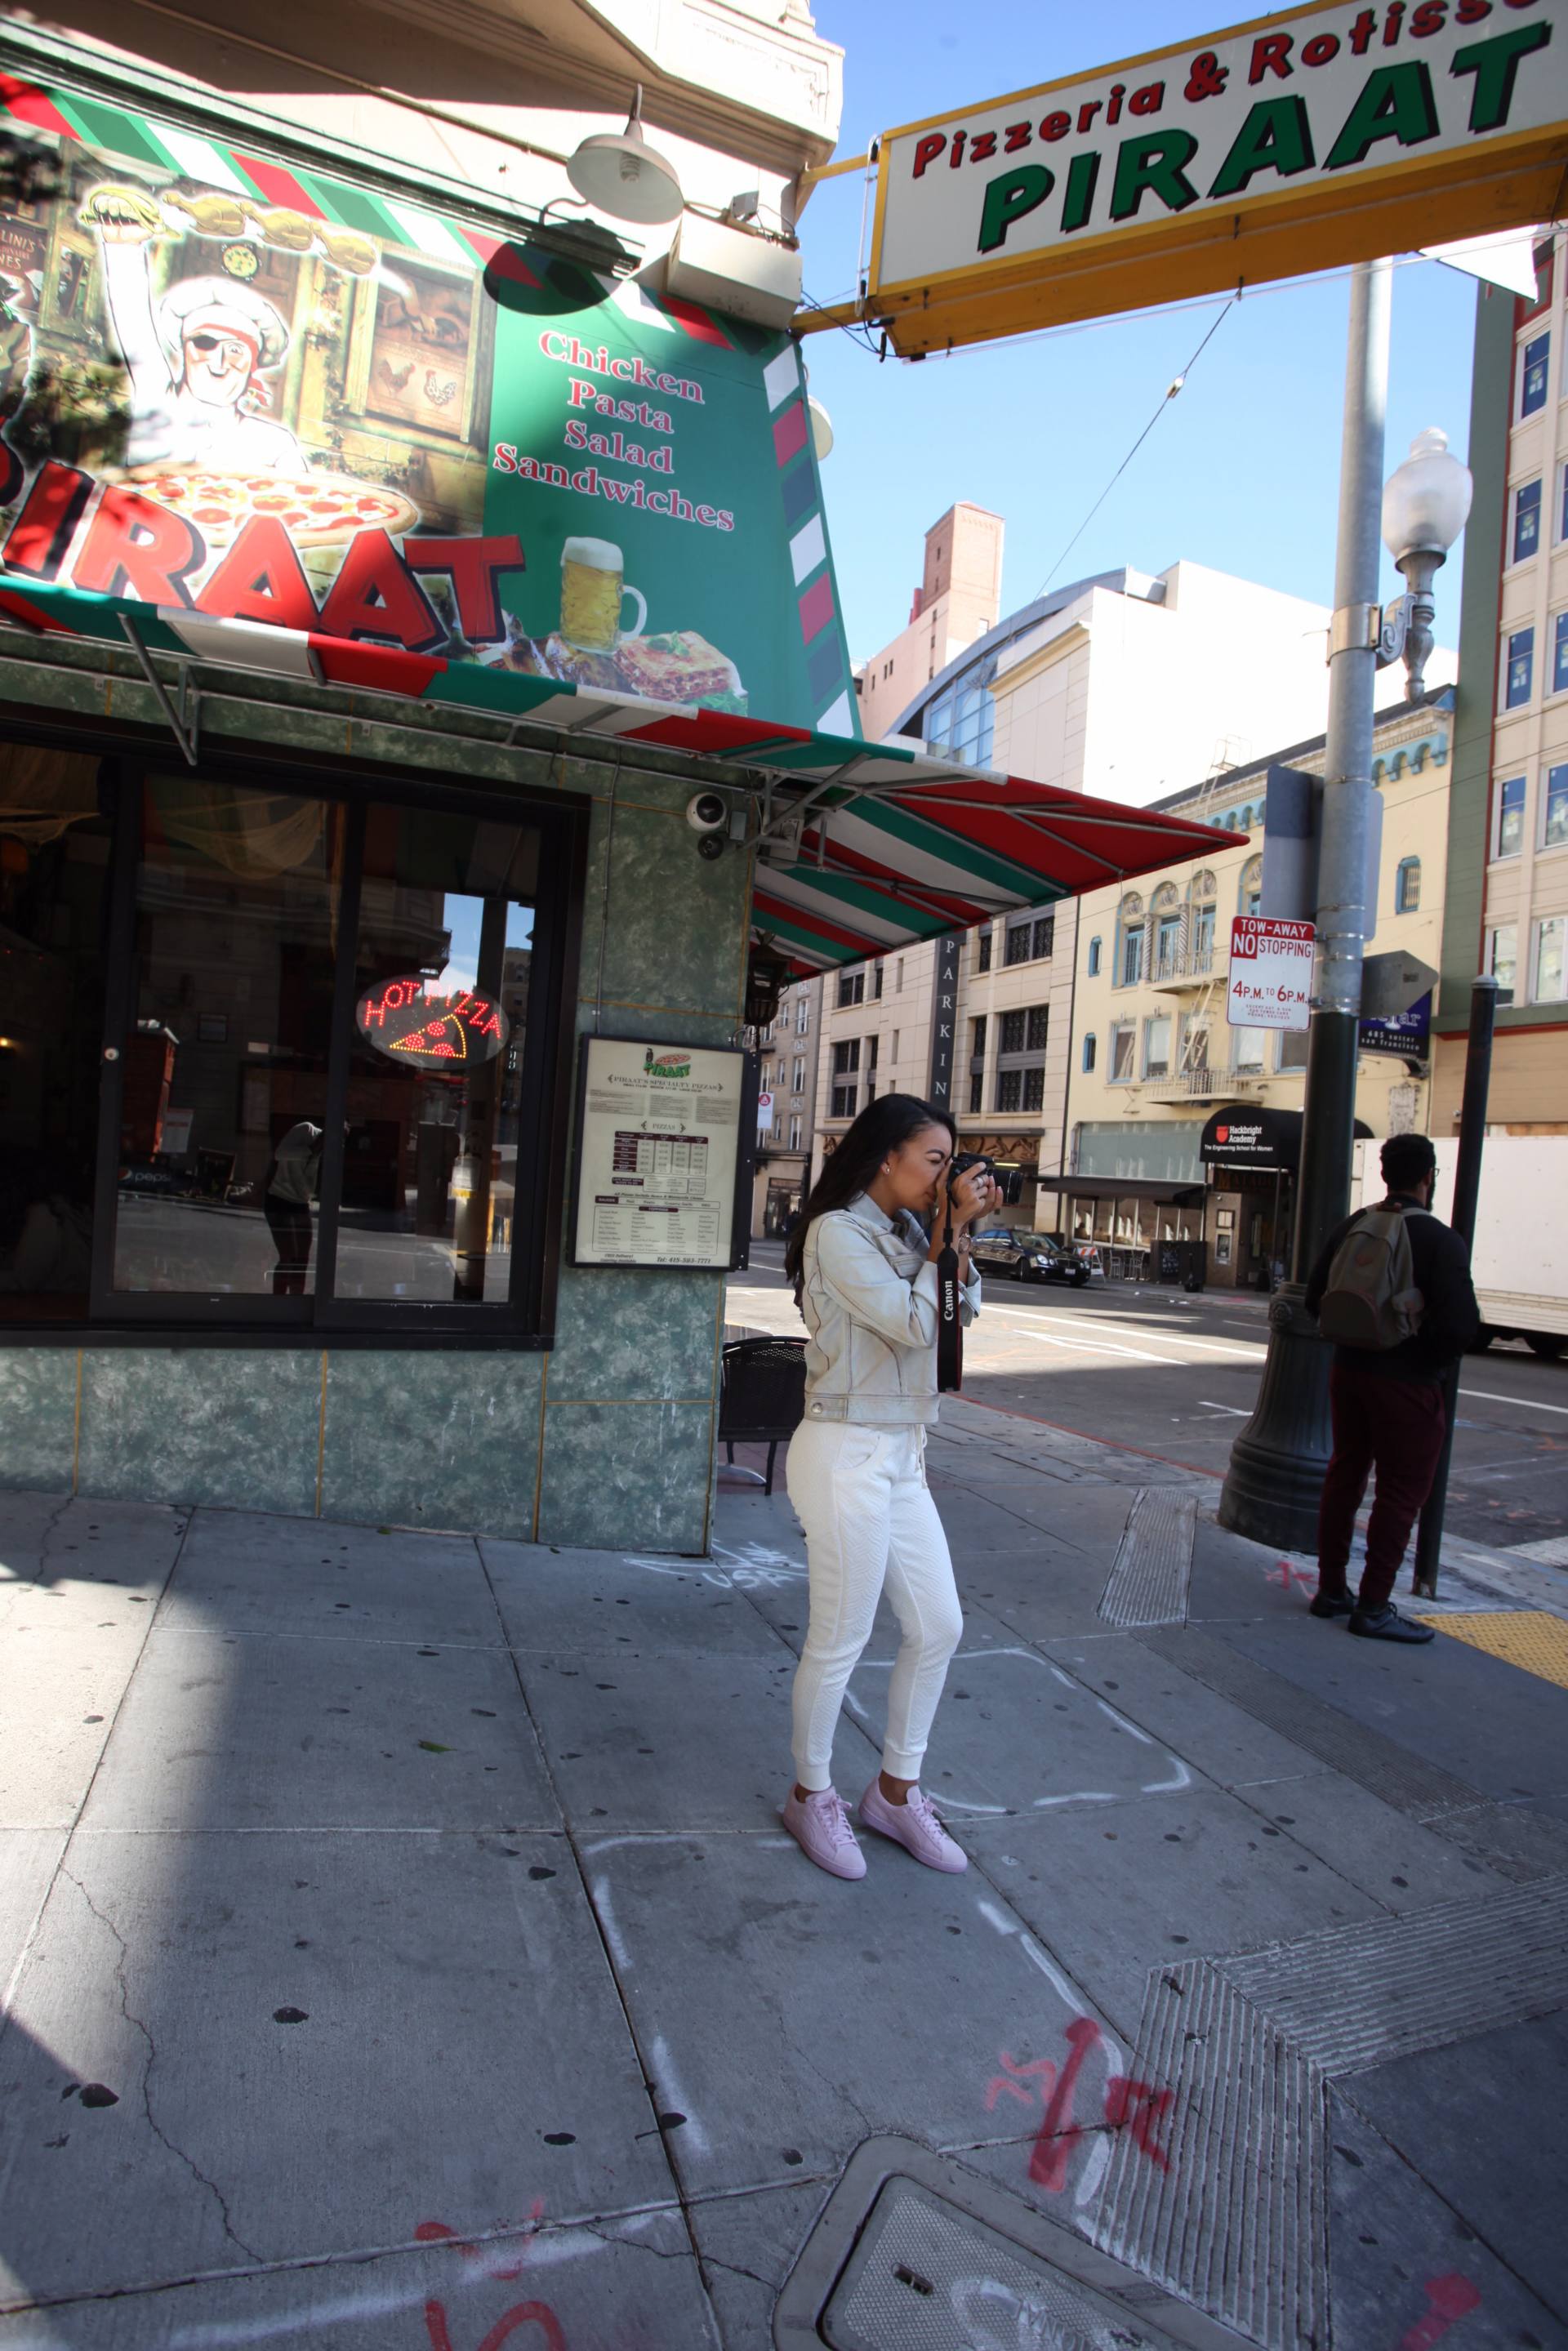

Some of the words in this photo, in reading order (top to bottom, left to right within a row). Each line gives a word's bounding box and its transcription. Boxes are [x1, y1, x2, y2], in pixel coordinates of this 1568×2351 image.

[912, 80, 1166, 180] Pizzeria
[1183, 51, 1231, 105] &
[1248, 0, 1544, 86] Rotiss
[977, 20, 1553, 254] PIRAAT
[538, 329, 706, 405] Chicken
[567, 377, 675, 434] Pasta
[564, 419, 675, 474] Salad
[492, 442, 735, 532] Sandwiches
[1233, 933, 1256, 955] NO
[1258, 938, 1312, 959] STOPPING
[1241, 919, 1307, 938] TOW-AWAY
[364, 980, 421, 1028] HOT
[424, 979, 503, 1040] PIZZA
[1266, 987, 1276, 996] TO
[1379, 1039, 1420, 1051] francisco
[1228, 1134, 1257, 1145] Academy
[1229, 1125, 1263, 1136] Hackbright
[944, 1280, 954, 1321] Canon
